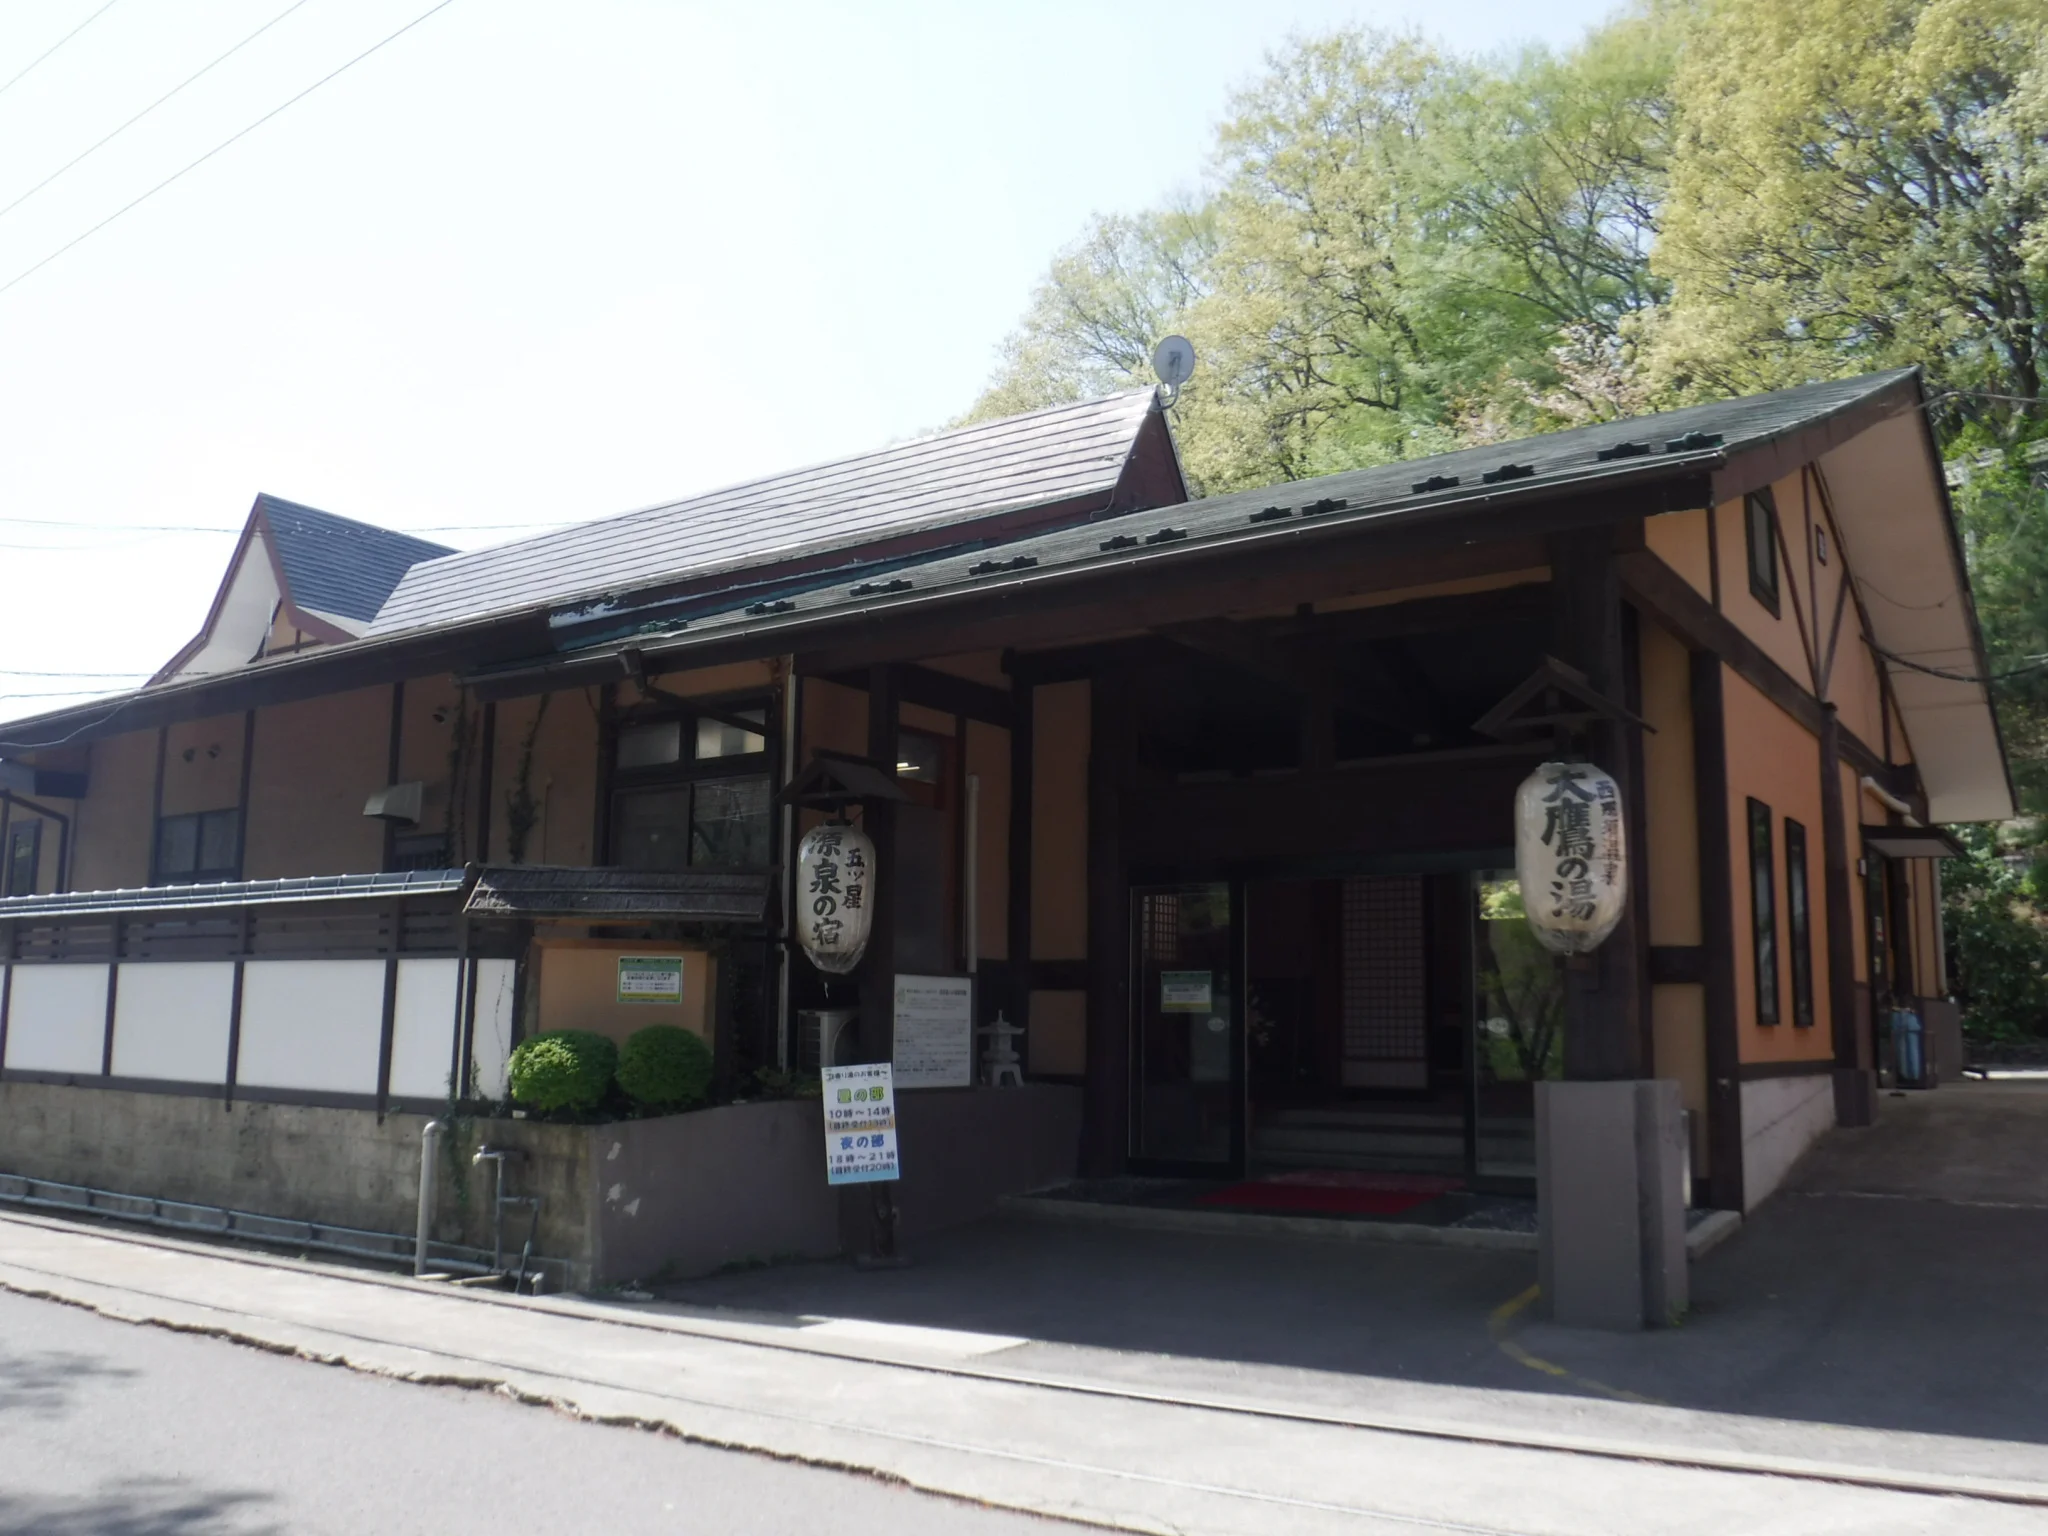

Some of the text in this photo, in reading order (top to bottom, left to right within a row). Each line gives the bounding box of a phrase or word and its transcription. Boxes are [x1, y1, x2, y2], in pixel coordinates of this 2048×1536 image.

[808, 831, 843, 946] 源泉の宿
[842, 848, 865, 909] 五ツ星
[1541, 770, 1597, 921] 大鷹の湯
